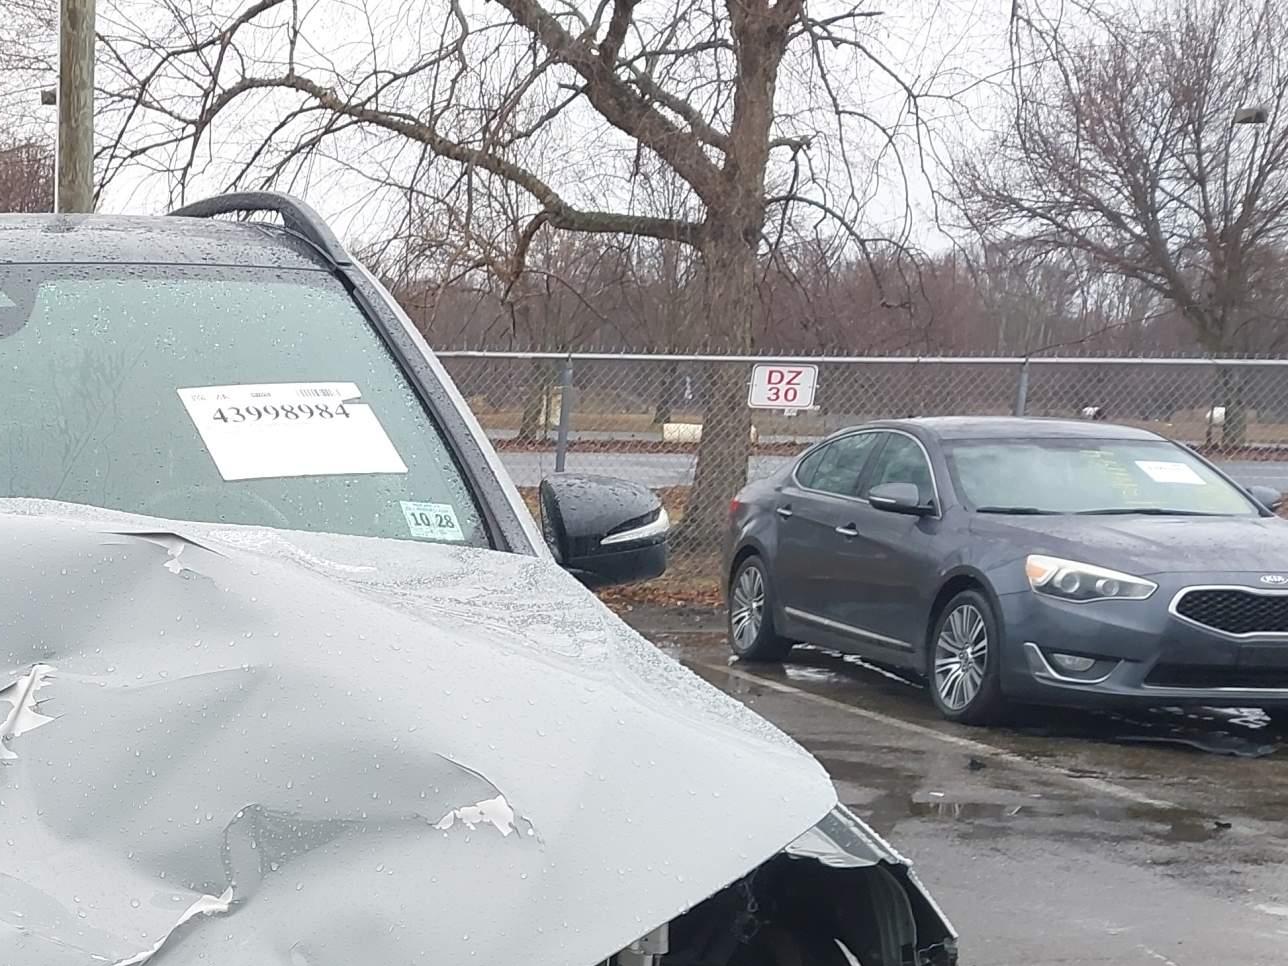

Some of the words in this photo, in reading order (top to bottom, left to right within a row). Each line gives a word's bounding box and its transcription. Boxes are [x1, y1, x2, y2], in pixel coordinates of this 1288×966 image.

[767, 369, 803, 386] DZ
[767, 386, 798, 402] 30
[213, 403, 350, 423] 43998984
[411, 512, 430, 527] 10
[435, 513, 455, 528] 28
